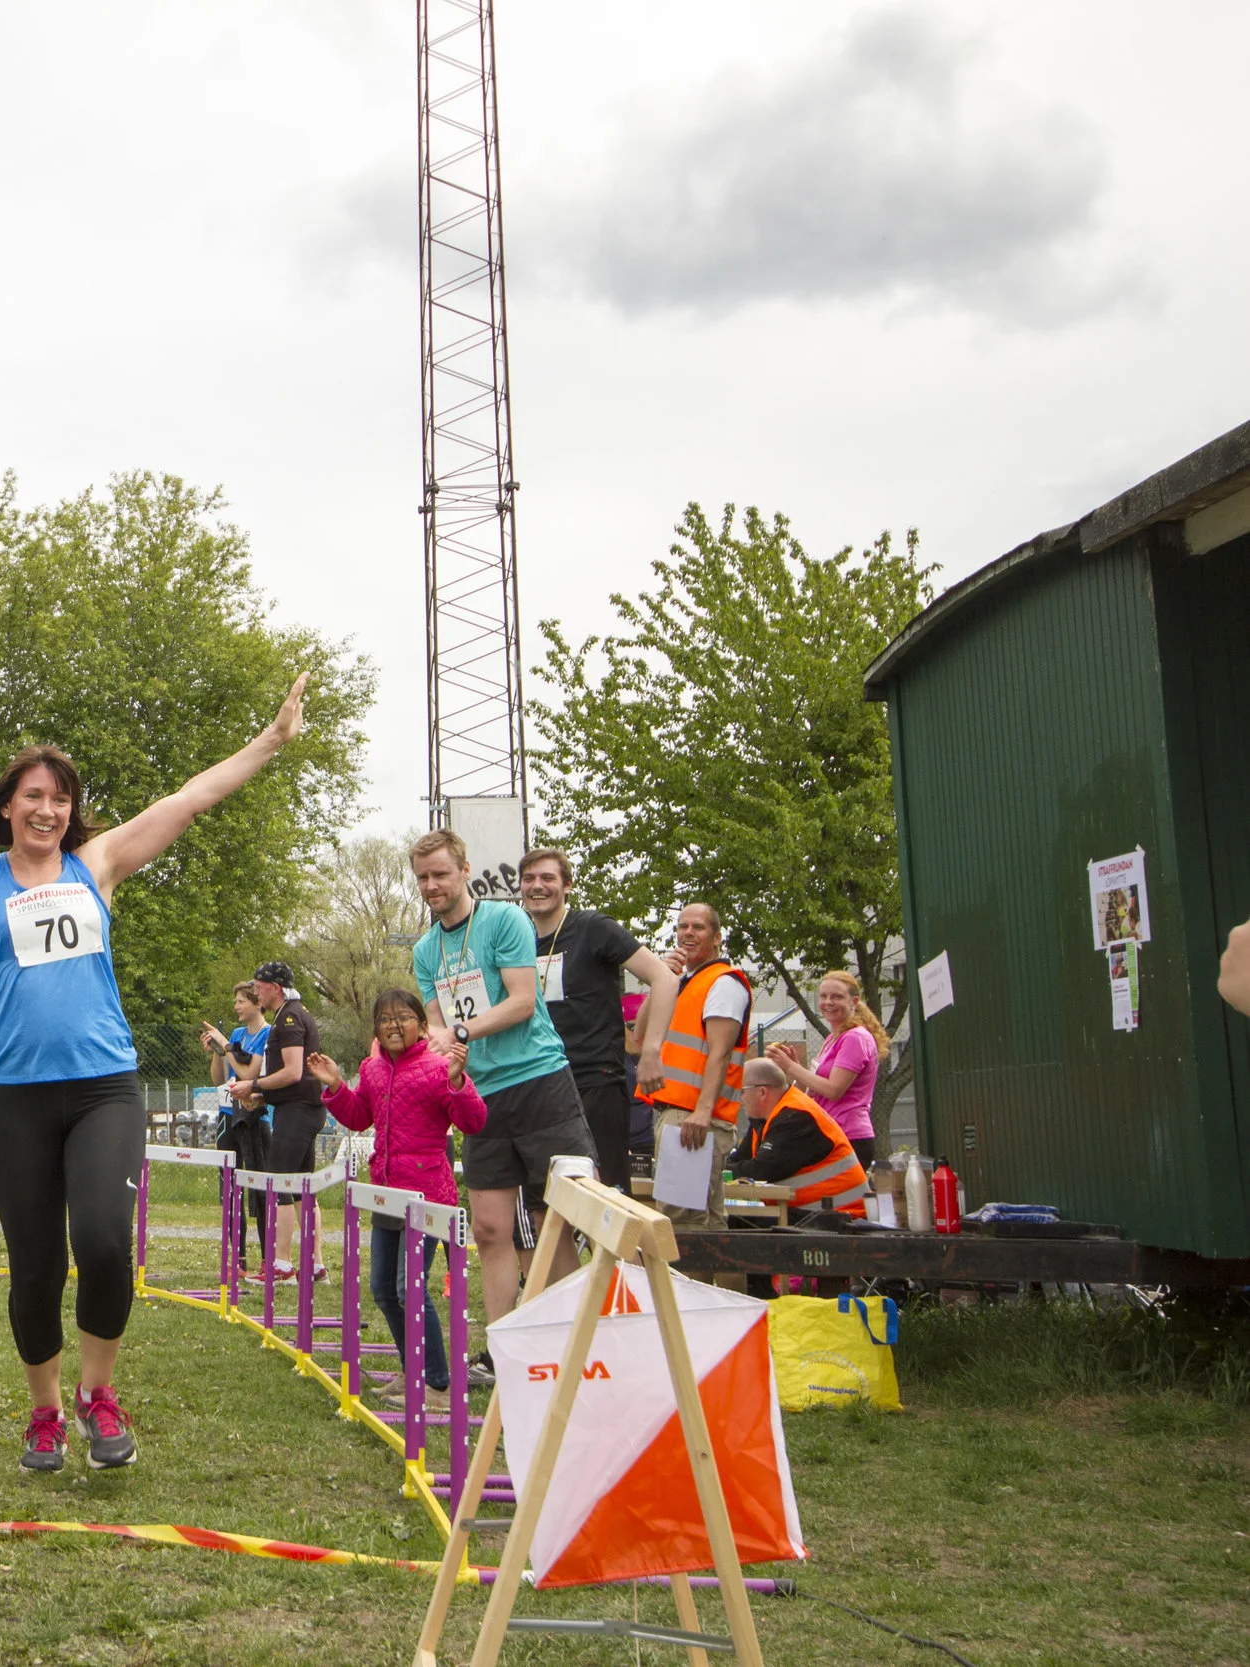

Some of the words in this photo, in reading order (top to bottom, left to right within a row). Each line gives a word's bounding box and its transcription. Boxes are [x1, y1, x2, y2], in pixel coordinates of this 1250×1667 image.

[8, 888, 88, 910] STRAFFRUNDAN
[35, 914, 79, 953] 70
[455, 996, 478, 1022] 42
